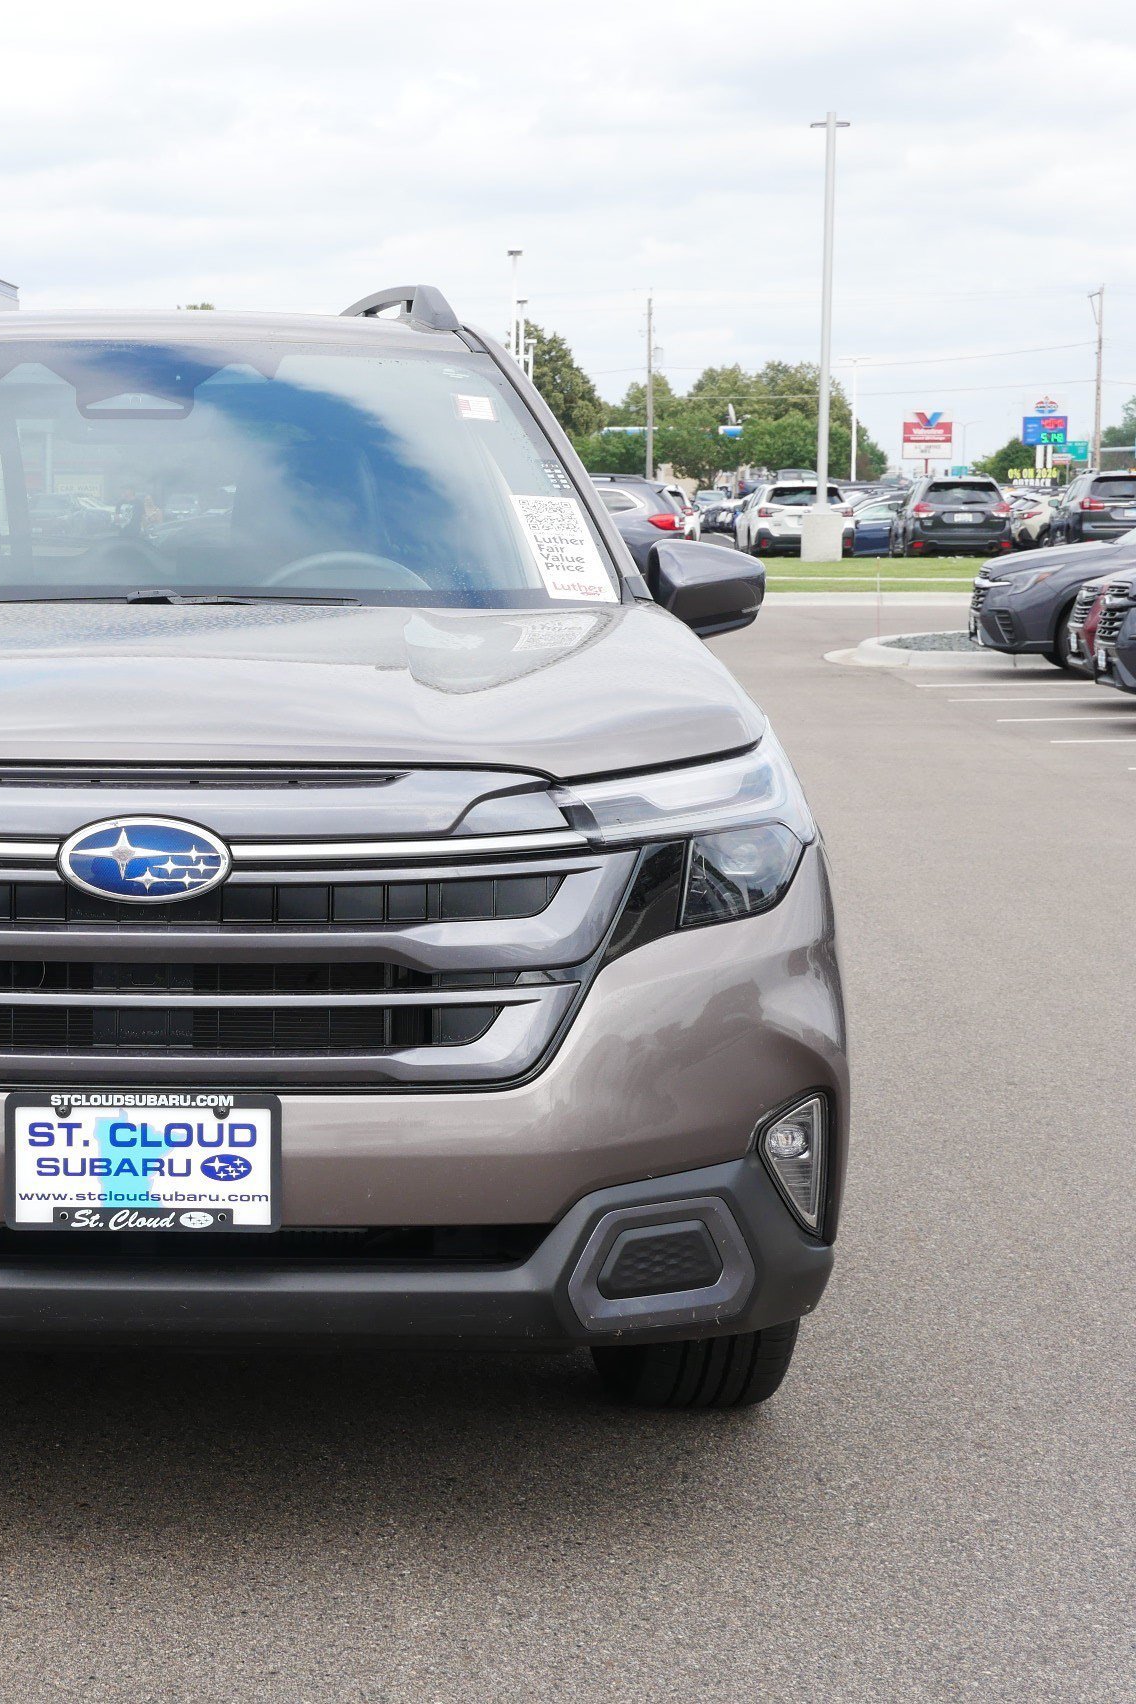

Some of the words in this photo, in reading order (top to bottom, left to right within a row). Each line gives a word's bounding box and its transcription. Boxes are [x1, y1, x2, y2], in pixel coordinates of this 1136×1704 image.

[1008, 468, 1021, 479] 0%
[1022, 468, 1035, 479] ON
[1035, 467, 1057, 479] 2026
[533, 535, 584, 546] Luther
[537, 544, 565, 553] Fair
[540, 552, 585, 563] Value
[545, 562, 585, 572] Price
[552, 581, 603, 593] Luther
[50, 1094, 234, 1107] STCLOUDSUBARU.COM
[28, 1122, 90, 1147] ST.
[109, 1122, 257, 1148] CLOUD
[36, 1157, 192, 1177] SUBARU
[18, 1190, 269, 1202] www.stcloudsubaru.com
[71, 1209, 104, 1228] St.
[108, 1209, 176, 1231] Cloud
